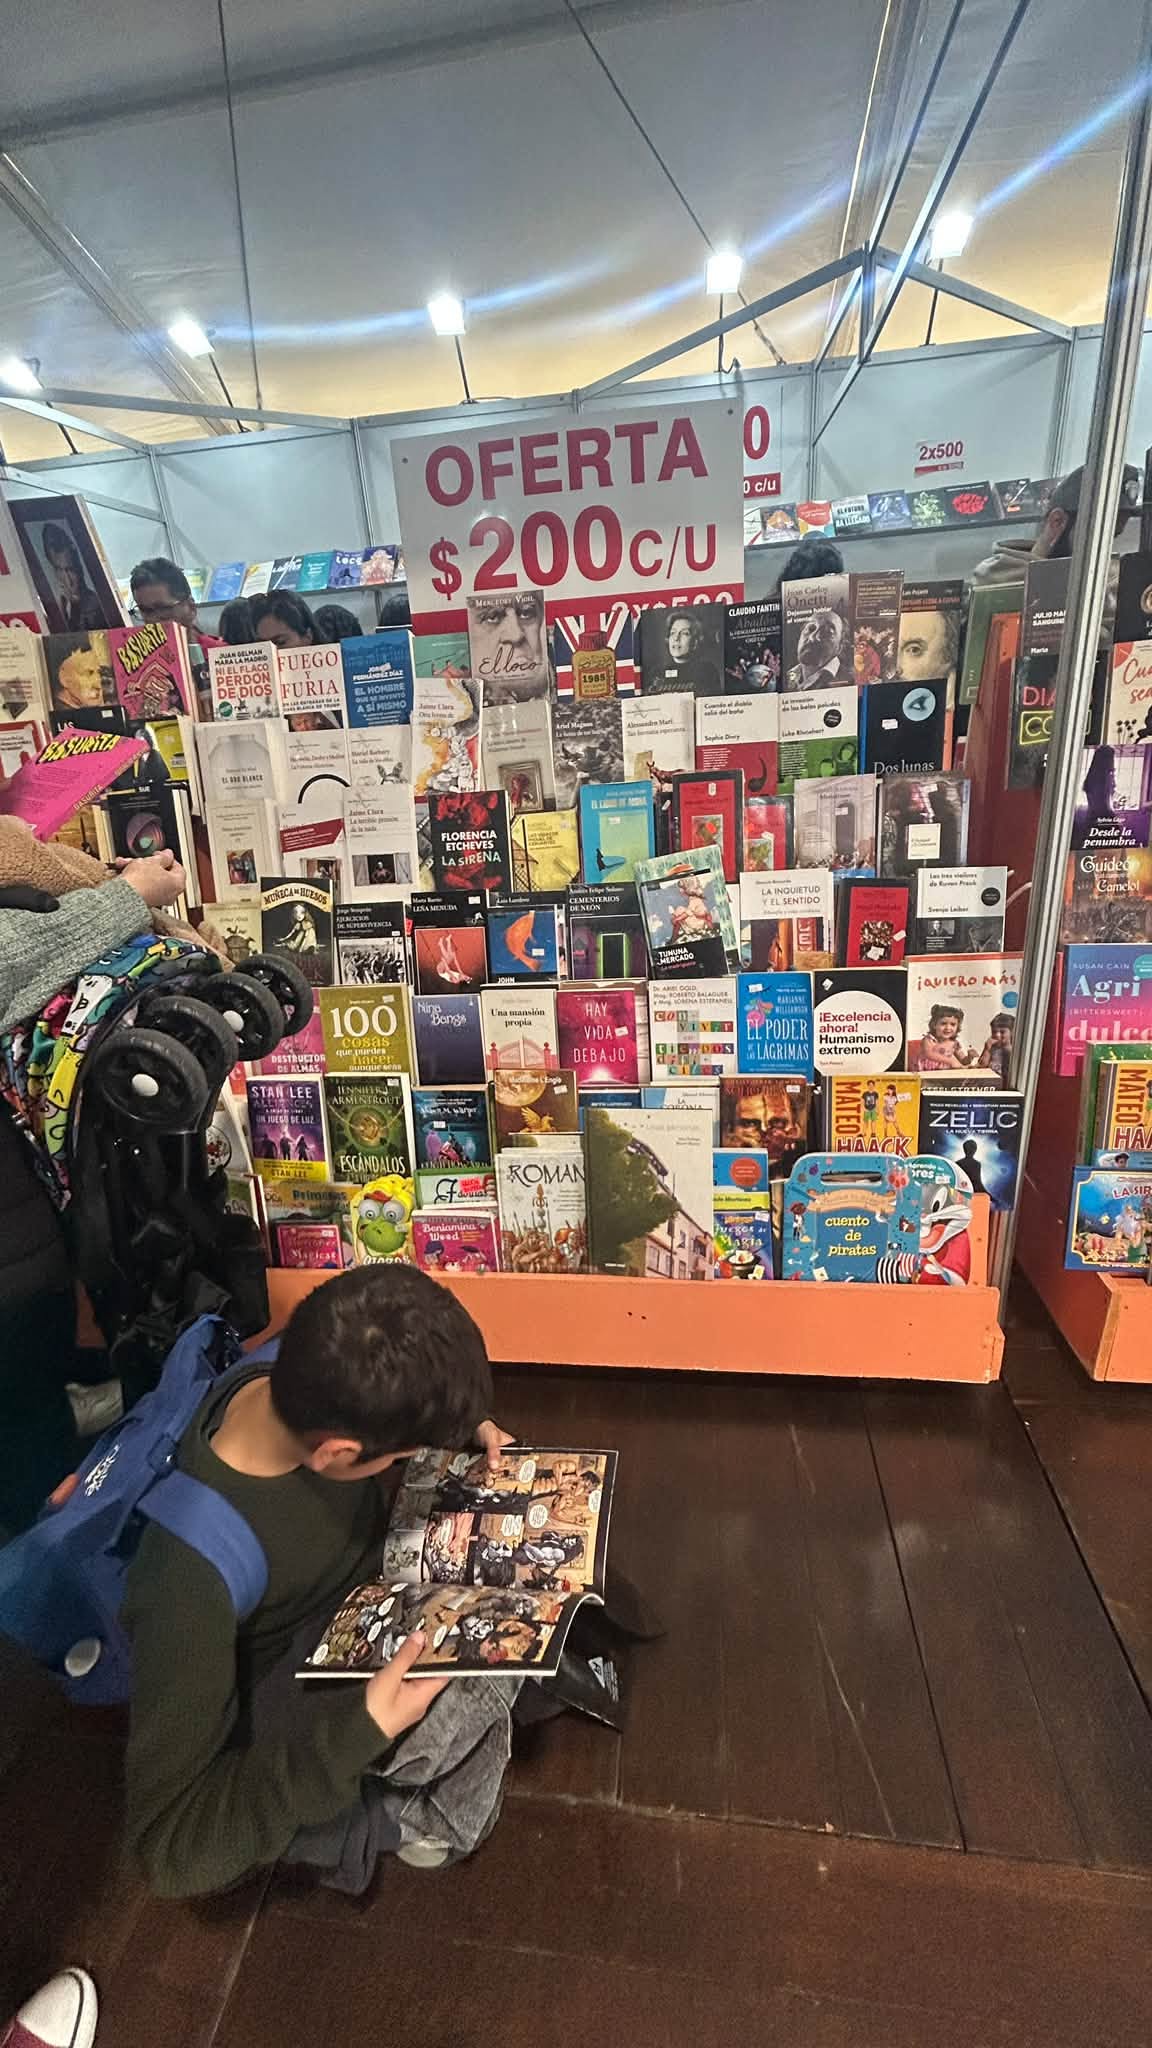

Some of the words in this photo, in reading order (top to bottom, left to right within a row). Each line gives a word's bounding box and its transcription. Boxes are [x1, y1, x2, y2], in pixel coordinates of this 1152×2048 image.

[919, 440, 964, 461] 2x500
[425, 416, 709, 508] OFERTA
[755, 479, 777, 493] c/u
[787, 593, 828, 609] Onetti
[728, 604, 756, 617] CLAUDIO
[1032, 611, 1053, 620] JULIO
[117, 623, 168, 674] BASURITA
[215, 657, 233, 666] MARA
[234, 657, 243, 665] LA
[244, 654, 268, 663] MADRID
[219, 652, 236, 660] JUAN
[278, 650, 339, 673] FUEGO
[478, 643, 501, 675] El
[502, 642, 541, 673] loco
[216, 667, 226, 676] NI
[227, 666, 239, 675] EL
[240, 662, 269, 674] FLACO
[304, 671, 313, 680] Y
[582, 673, 606, 684] 1985
[217, 686, 238, 700] DE
[239, 683, 273, 698] DIOS
[280, 679, 339, 699] FURIA
[354, 687, 367, 697] EL
[368, 682, 407, 694] HOMBRE
[356, 704, 365, 714] A
[376, 699, 407, 712] MISMO
[37, 734, 122, 764] BASURITA
[873, 761, 900, 775] Dos
[901, 759, 935, 772] lunas
[441, 829, 498, 842] FLORENCIA
[1089, 826, 1120, 837] Desde
[1121, 826, 1133, 836] la
[445, 839, 495, 852] ETCHEVES
[1082, 836, 1137, 849] penumbra
[441, 856, 457, 867] LA
[458, 850, 502, 866] SIRENA
[761, 888, 773, 896] LA
[774, 885, 821, 896] INQUIETUD
[1096, 879, 1140, 893] Camelot
[263, 886, 295, 906] MUÑECA
[299, 886, 329, 905] HUESOS
[569, 895, 620, 906] CEMENTERIOS
[762, 897, 768, 905] Y
[770, 896, 780, 905] EL
[783, 895, 821, 905] SENTIDO
[569, 905, 580, 913] DE
[581, 902, 602, 913] NEÓN
[346, 920, 393, 929] SUPERVIVENCIA
[656, 952, 694, 966] MERCADO
[1072, 962, 1104, 970] SUSAN
[1106, 962, 1130, 970] CAIN
[917, 974, 978, 991] ¡QUIERO
[982, 970, 1017, 987] MÁS
[669, 991, 696, 999] ROBERTO
[697, 990, 729, 998] BALAGUER
[680, 984, 698, 992] GOLD
[1071, 974, 1142, 1004] Agri
[417, 1001, 443, 1013] Nina
[491, 1007, 508, 1017] Una
[509, 1005, 546, 1017] mansión
[586, 1002, 608, 1017] HAY
[330, 1004, 398, 1039] 100
[504, 1017, 533, 1030] propia
[819, 1012, 892, 1024] ¡Excelencia
[584, 1026, 614, 1041] VIDA
[746, 1019, 759, 1041] EL
[765, 1018, 809, 1041] PODER
[819, 1022, 859, 1034] ahora!
[341, 1037, 390, 1050] cosas
[819, 1033, 895, 1045] Humanismo
[335, 1049, 352, 1058] que
[354, 1047, 387, 1056] puedes
[573, 1047, 626, 1063] DEBAJO
[757, 1041, 809, 1061] LÁGRIMAS
[819, 1045, 871, 1056] extremo
[271, 1054, 326, 1065] DESTRUCTOR
[352, 1055, 396, 1066] hacer
[277, 1064, 288, 1073] DE
[252, 1085, 284, 1100] STAN
[289, 1085, 314, 1099] LEE
[337, 1084, 378, 1095] JENNIFER
[331, 1094, 401, 1106] ARMENTROUT
[677, 1097, 687, 1106] LA
[1115, 1068, 1149, 1125] MATEO
[835, 1081, 862, 1135] MATEO
[267, 1115, 289, 1124] JUEGO
[290, 1115, 301, 1124] DE
[302, 1116, 314, 1125] LUZ
[929, 1110, 1018, 1129] ZELIC
[835, 1136, 911, 1158] HAACK
[340, 1152, 407, 1176] ESCÁNDALOS
[271, 1170, 291, 1178] STAN
[293, 1170, 308, 1178] LEE
[1112, 1187, 1130, 1199] LA
[824, 1214, 870, 1228] cuento
[844, 1229, 862, 1242] de
[828, 1242, 878, 1258] piratas
